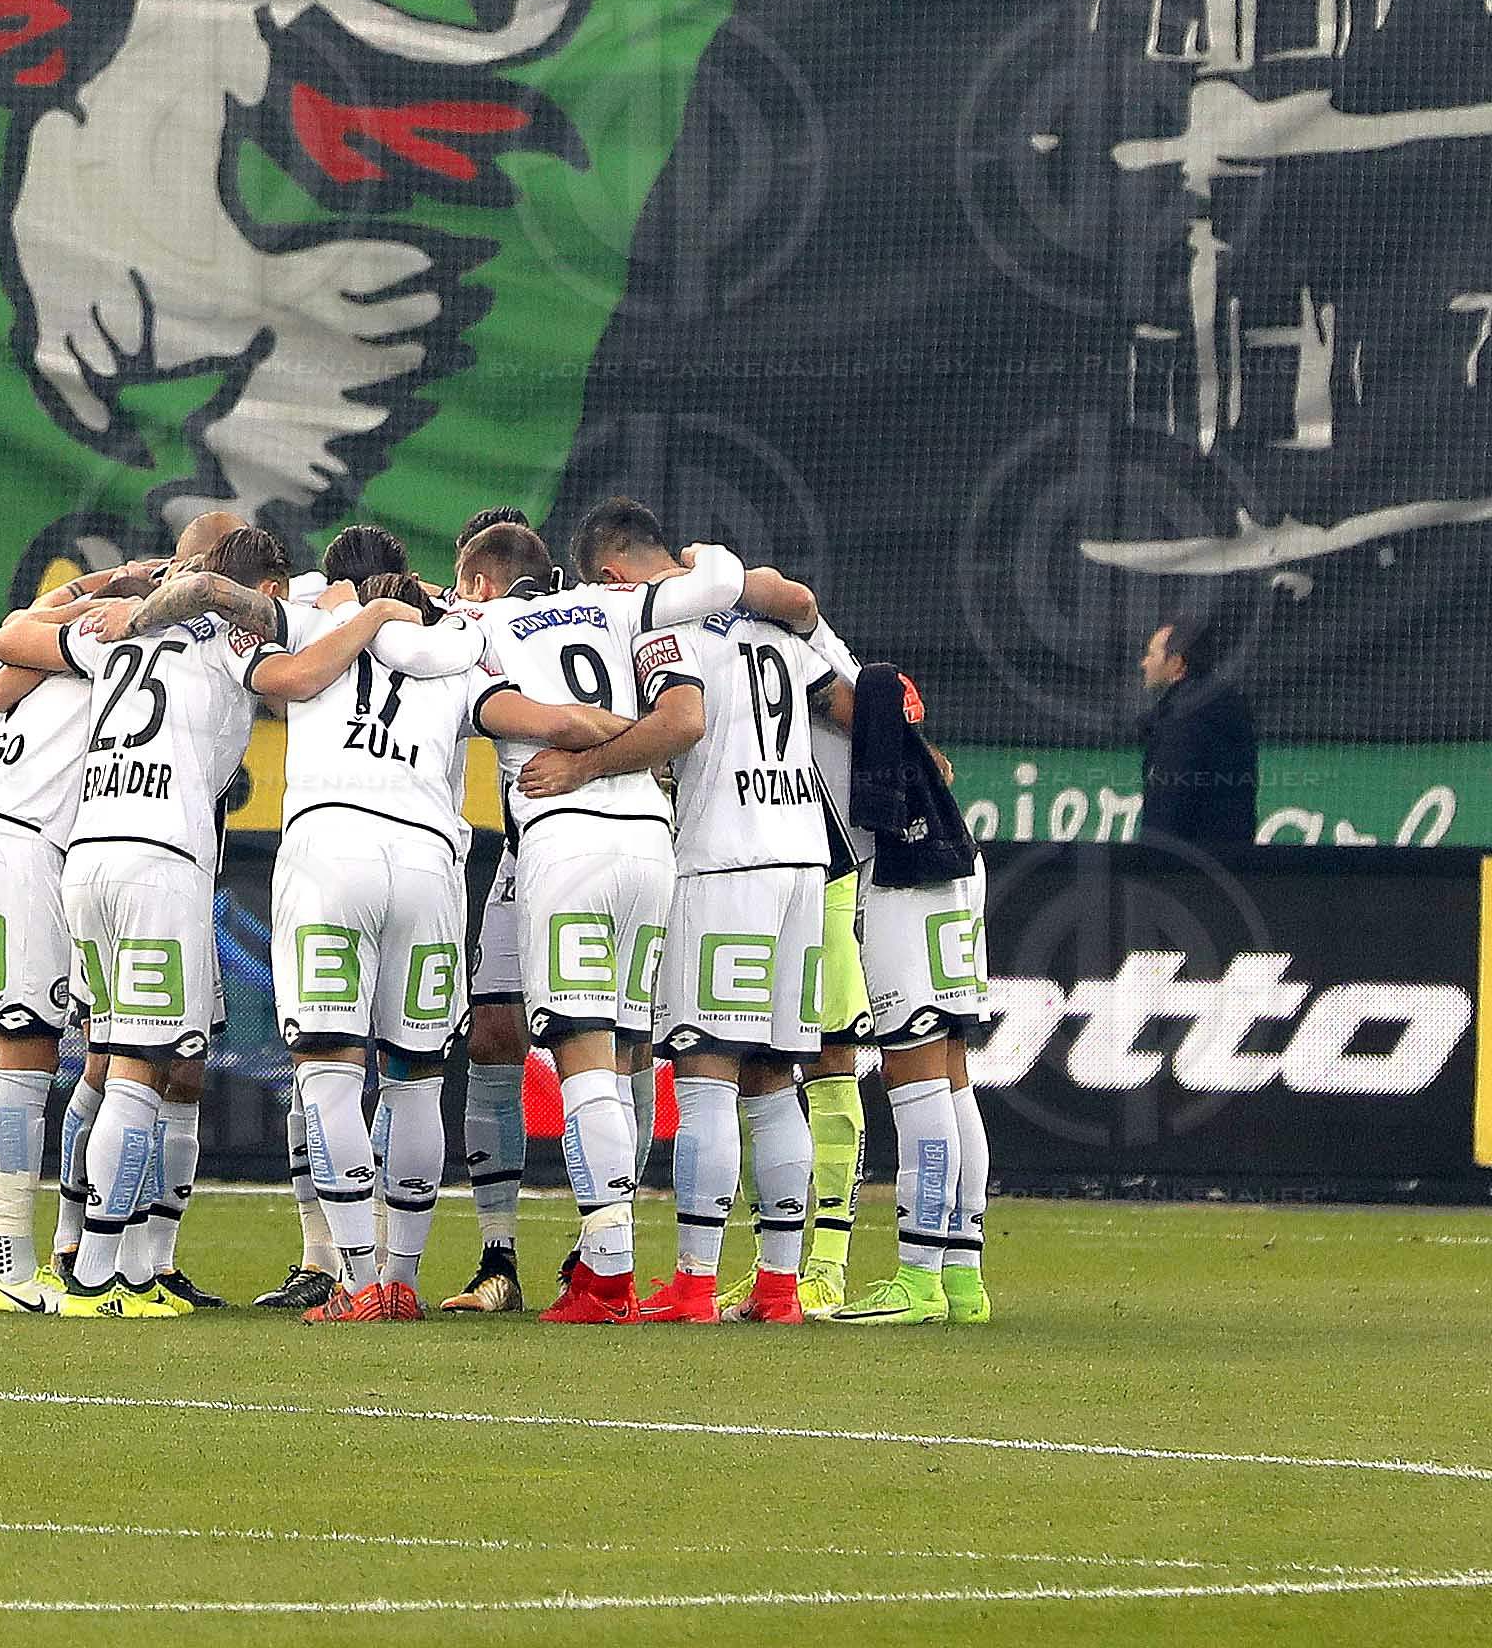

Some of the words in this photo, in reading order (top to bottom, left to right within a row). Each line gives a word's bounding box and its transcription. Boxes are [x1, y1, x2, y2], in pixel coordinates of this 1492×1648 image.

[88, 640, 189, 753] 25
[559, 643, 613, 716] 9
[737, 642, 793, 762] 19
[116, 947, 175, 1008] E
[300, 932, 352, 994] E
[556, 921, 615, 983] E
[711, 943, 774, 1004] E
[953, 950, 1474, 1095] otto
